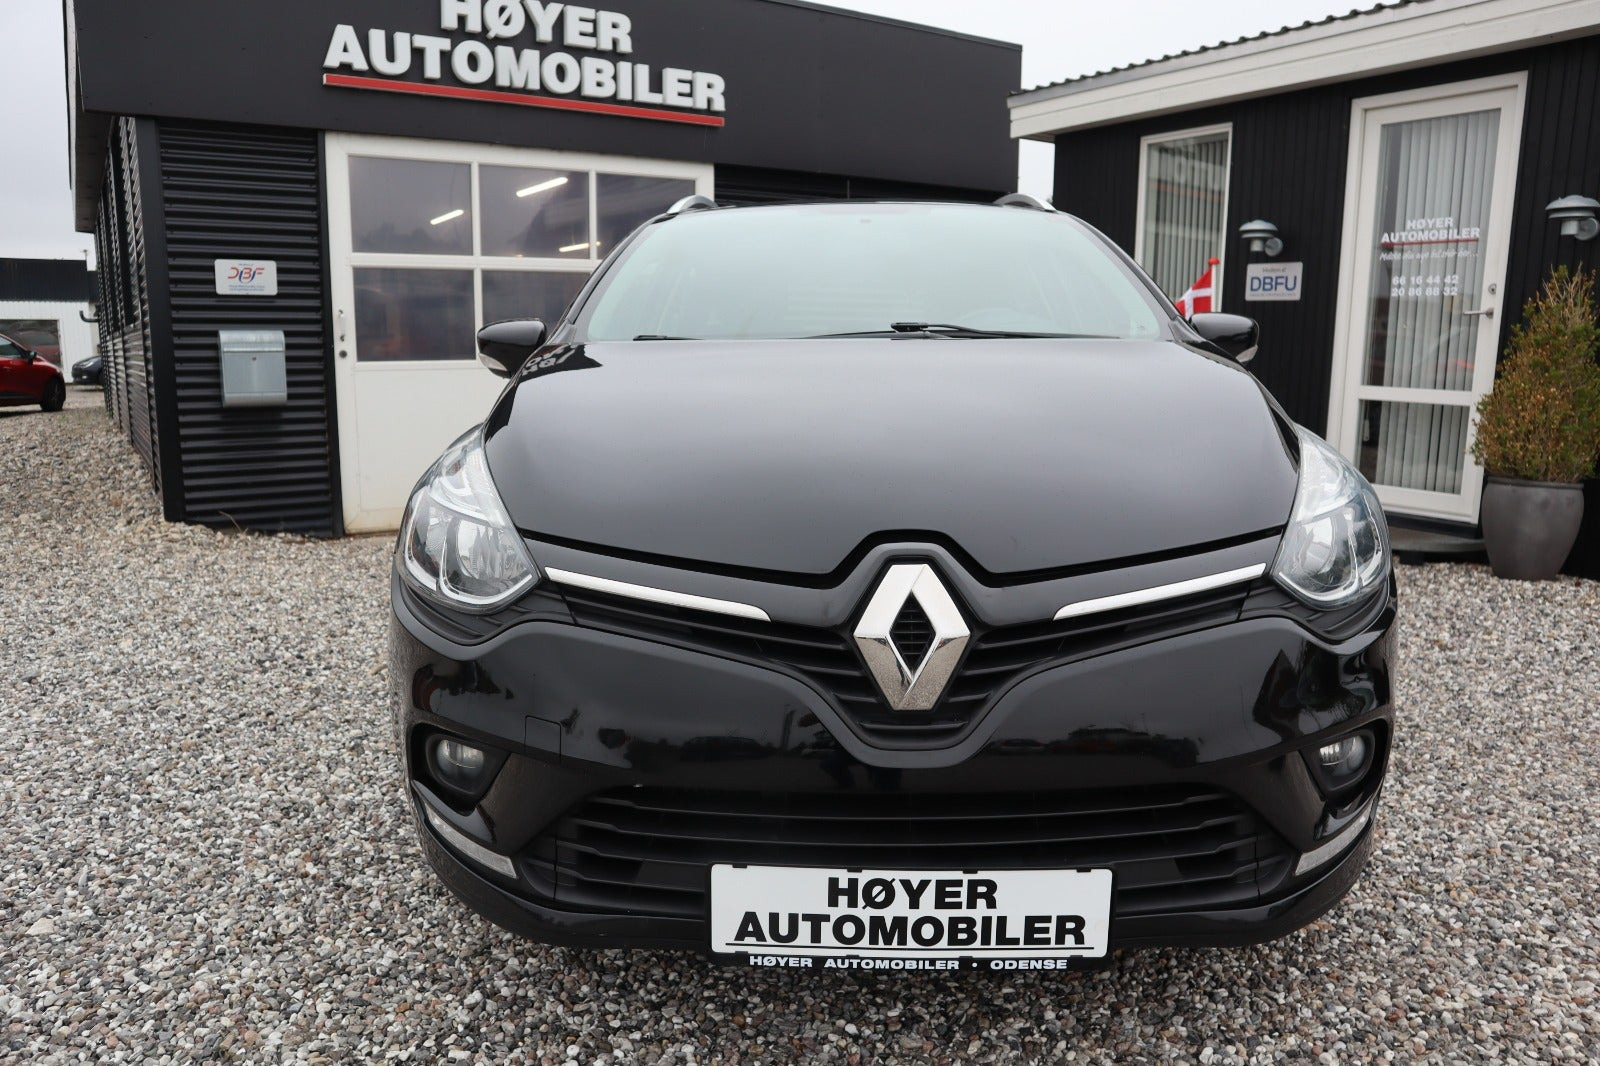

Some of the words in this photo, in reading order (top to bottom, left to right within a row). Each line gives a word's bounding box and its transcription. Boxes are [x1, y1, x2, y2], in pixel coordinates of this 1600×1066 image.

[440, 0, 633, 53] HØYER
[323, 24, 726, 112] AUTOMOBILER
[1381, 227, 1480, 243] AUTOMOBILER
[1250, 275, 1297, 292] DBFU
[1426, 275, 1440, 284] 44
[1444, 274, 1459, 284] 42
[1391, 287, 1405, 297] 20
[1443, 286, 1458, 296] 32
[827, 877, 998, 910] HØYER
[734, 911, 1086, 947] AUTOMOBILER
[749, 955, 813, 968] HØYER
[824, 958, 960, 970] AUTOMOBILER
[990, 959, 1068, 970] ODENSE
